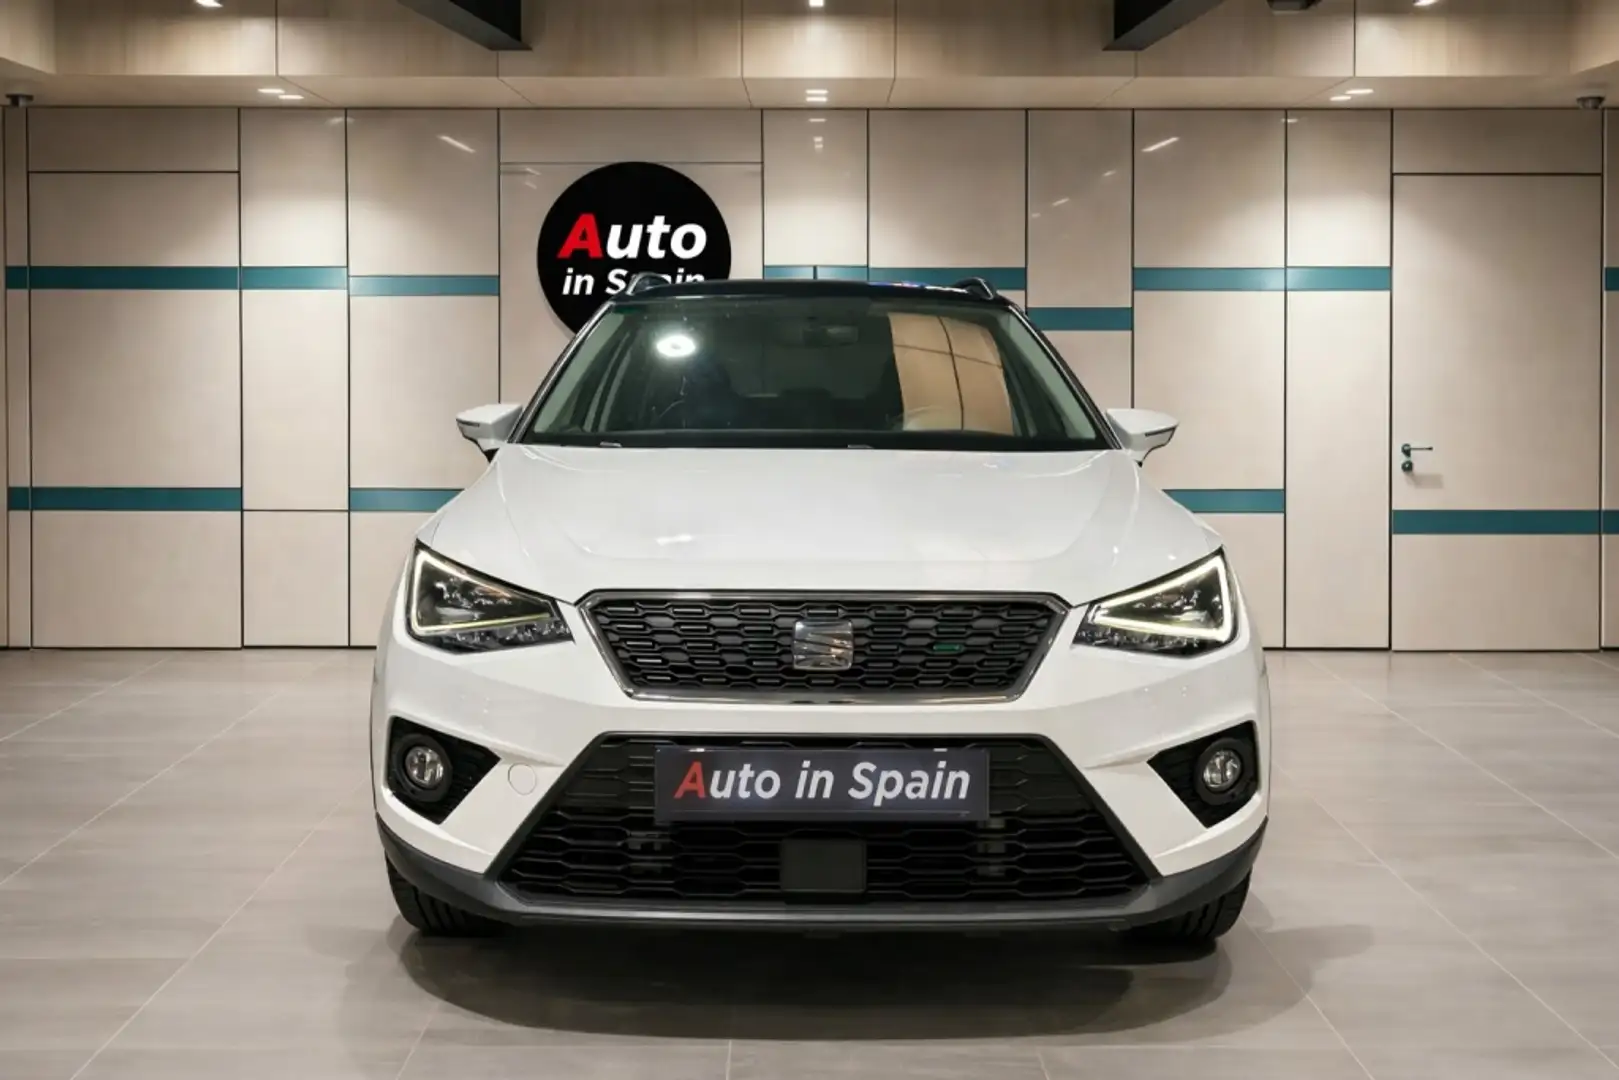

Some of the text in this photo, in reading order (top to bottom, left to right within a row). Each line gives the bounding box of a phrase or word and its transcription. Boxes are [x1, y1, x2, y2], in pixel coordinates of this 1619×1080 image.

[557, 213, 707, 260] Auto
[562, 267, 595, 296] in
[674, 759, 971, 807] Auto in Spain
